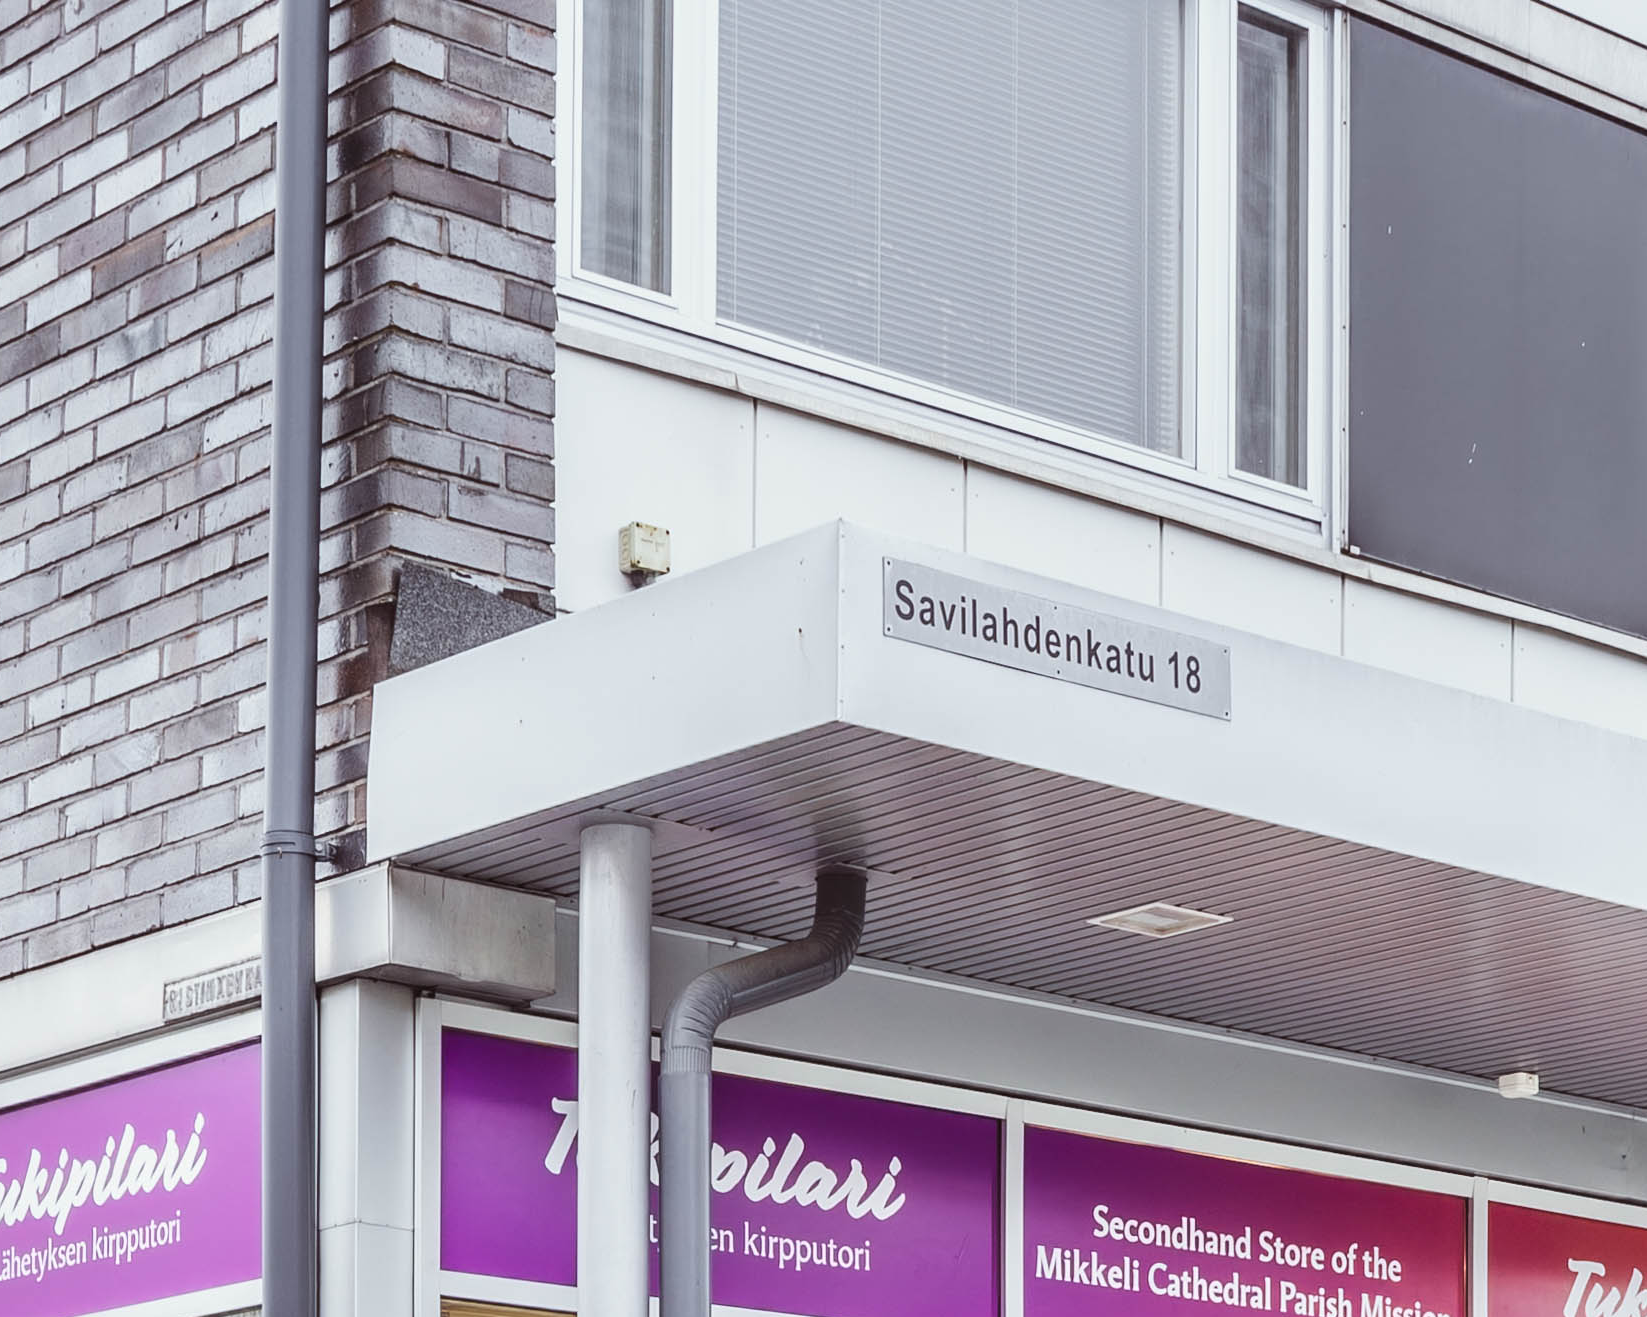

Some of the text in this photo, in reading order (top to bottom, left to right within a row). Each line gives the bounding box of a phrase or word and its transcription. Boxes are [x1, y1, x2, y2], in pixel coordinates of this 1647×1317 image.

[895, 580, 1201, 693] Savilahdenkatu 18
[545, 1097, 905, 1220] Tpilari
[92, 1210, 180, 1264] kirpputori
[744, 1221, 871, 1271] kirpputori
[1093, 1205, 1401, 1282] Secondhand Store of the
[1036, 1245, 1139, 1291] Mikkeli
[1148, 1263, 1271, 1310] Cathedral
